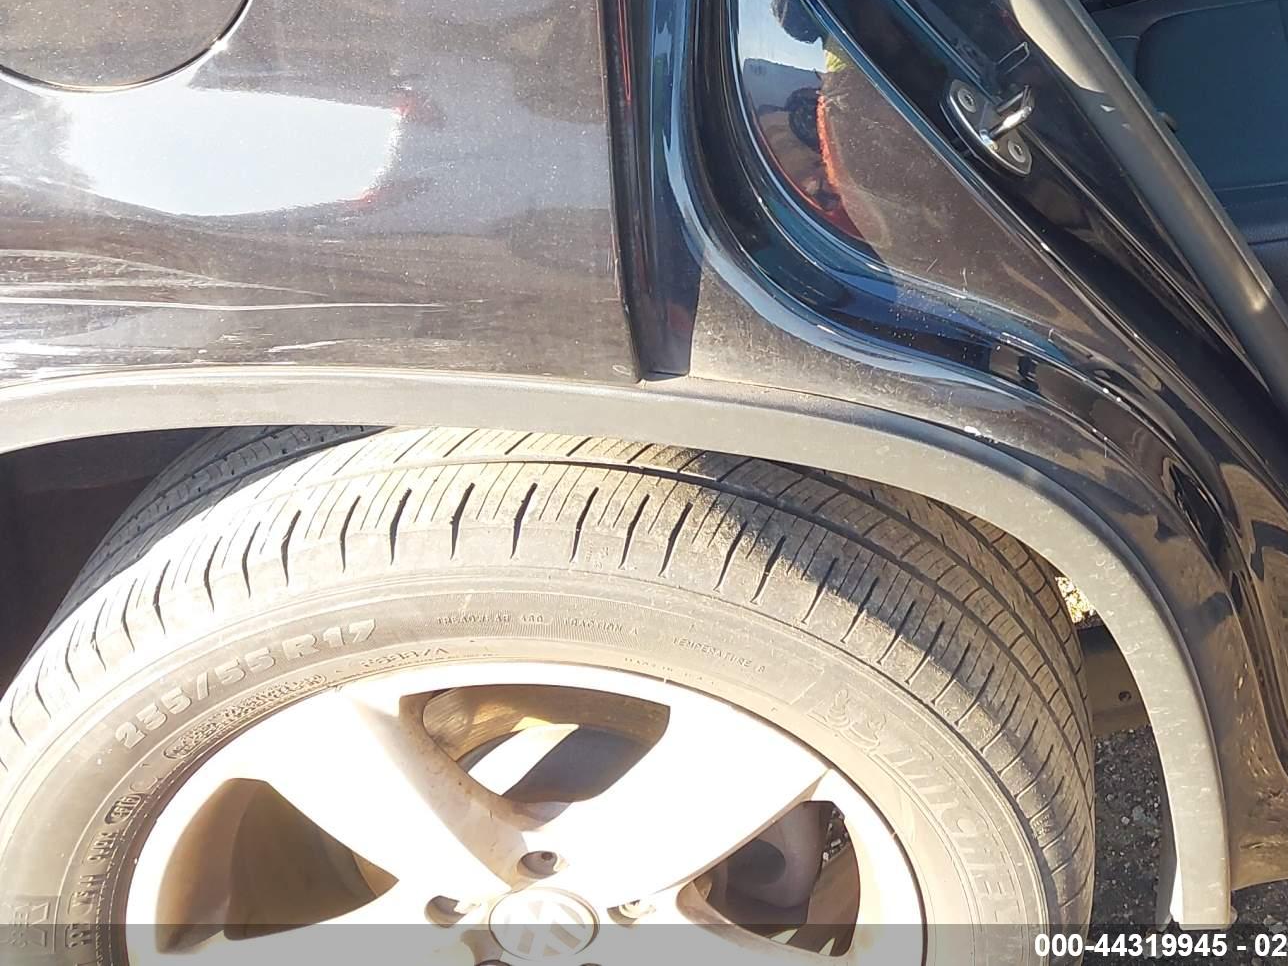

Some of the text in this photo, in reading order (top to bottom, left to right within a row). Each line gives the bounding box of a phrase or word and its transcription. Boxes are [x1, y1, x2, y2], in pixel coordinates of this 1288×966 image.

[114, 646, 276, 750] 235/55
[281, 618, 377, 660] R17
[672, 635, 753, 668] TEMPERATURE
